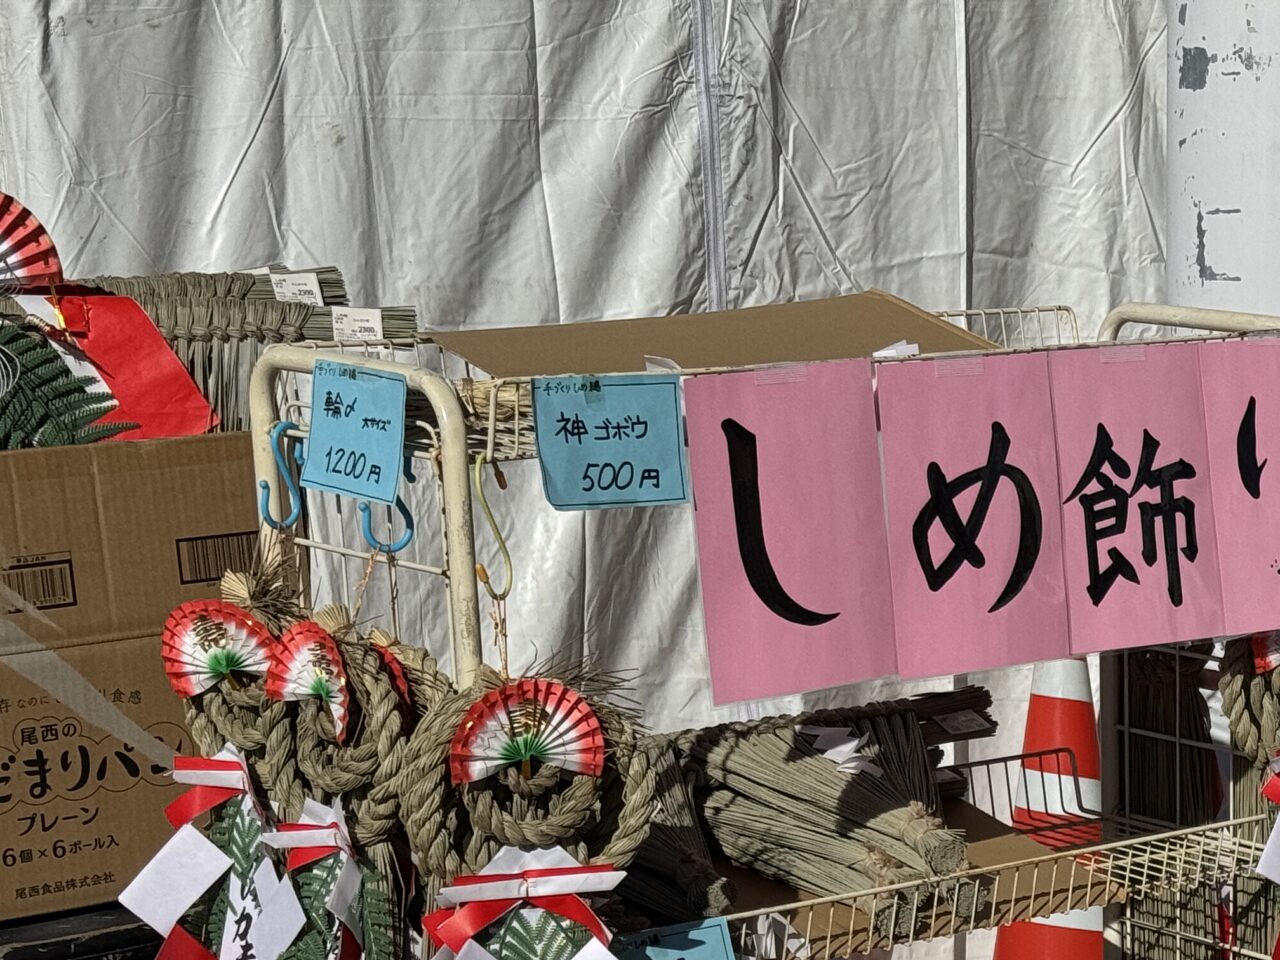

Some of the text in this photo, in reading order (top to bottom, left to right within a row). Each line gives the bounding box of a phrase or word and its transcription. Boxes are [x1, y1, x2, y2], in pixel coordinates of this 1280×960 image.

[361, 416, 392, 432] 大サイズ
[325, 445, 382, 484] 1200円
[582, 461, 660, 492] 500円
[20, 723, 78, 746] 尾西の
[17, 807, 99, 836] プレーン
[15, 872, 116, 900] 尾西食品株式会社
